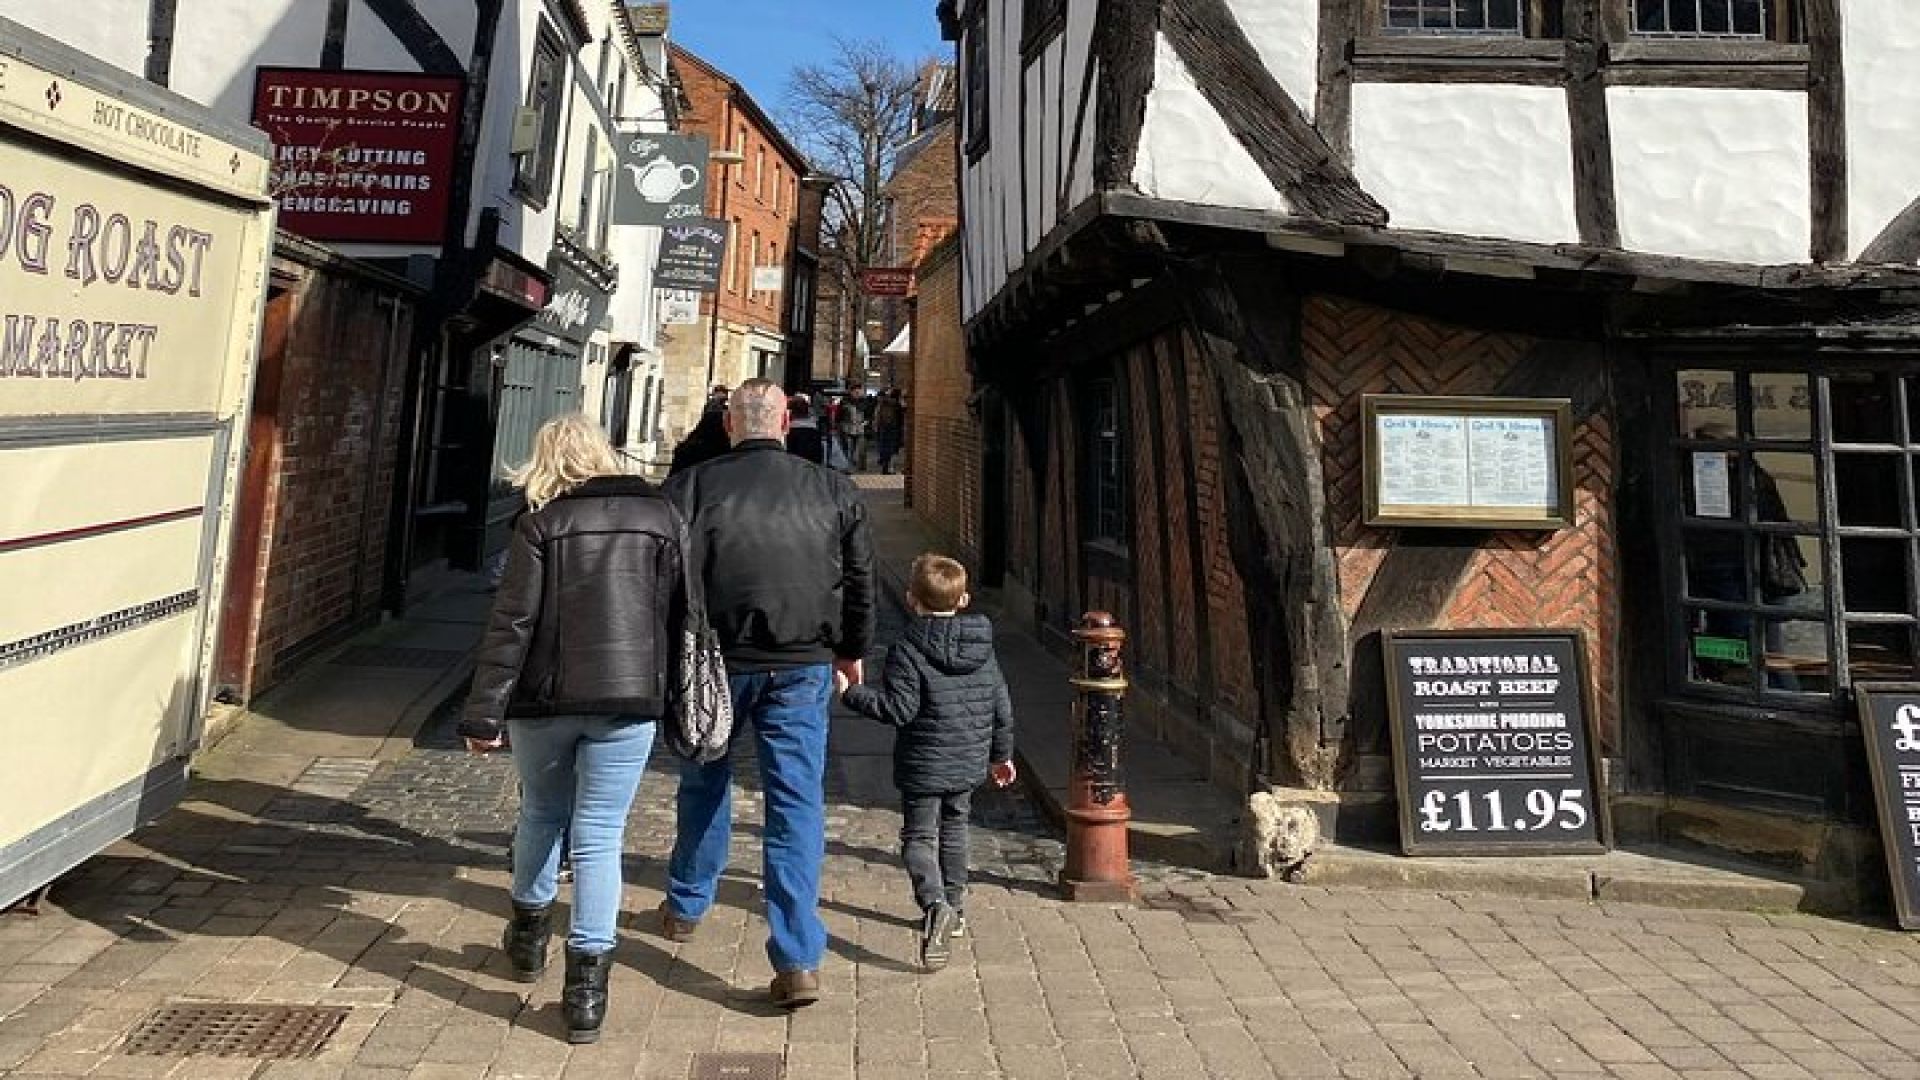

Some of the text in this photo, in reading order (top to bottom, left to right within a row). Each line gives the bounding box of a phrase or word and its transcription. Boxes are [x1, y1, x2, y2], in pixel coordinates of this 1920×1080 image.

[267, 85, 452, 113] TIMPSON
[93, 100, 201, 157] HOT CHOCOLATE
[279, 146, 321, 162] KEY
[282, 196, 412, 215] ENGRAVING
[64, 203, 213, 297] ROAST
[0, 314, 158, 382] MARKET
[1408, 656, 1560, 675] TRADITIONAL
[1413, 679, 1560, 696] ROAST BEEF
[1415, 712, 1566, 730] YORKSHIRE PUDDING
[1418, 732, 1574, 752] POTATOES
[1418, 755, 1572, 769] MARKET VEGETABLES
[1418, 788, 1588, 832] £11.95
